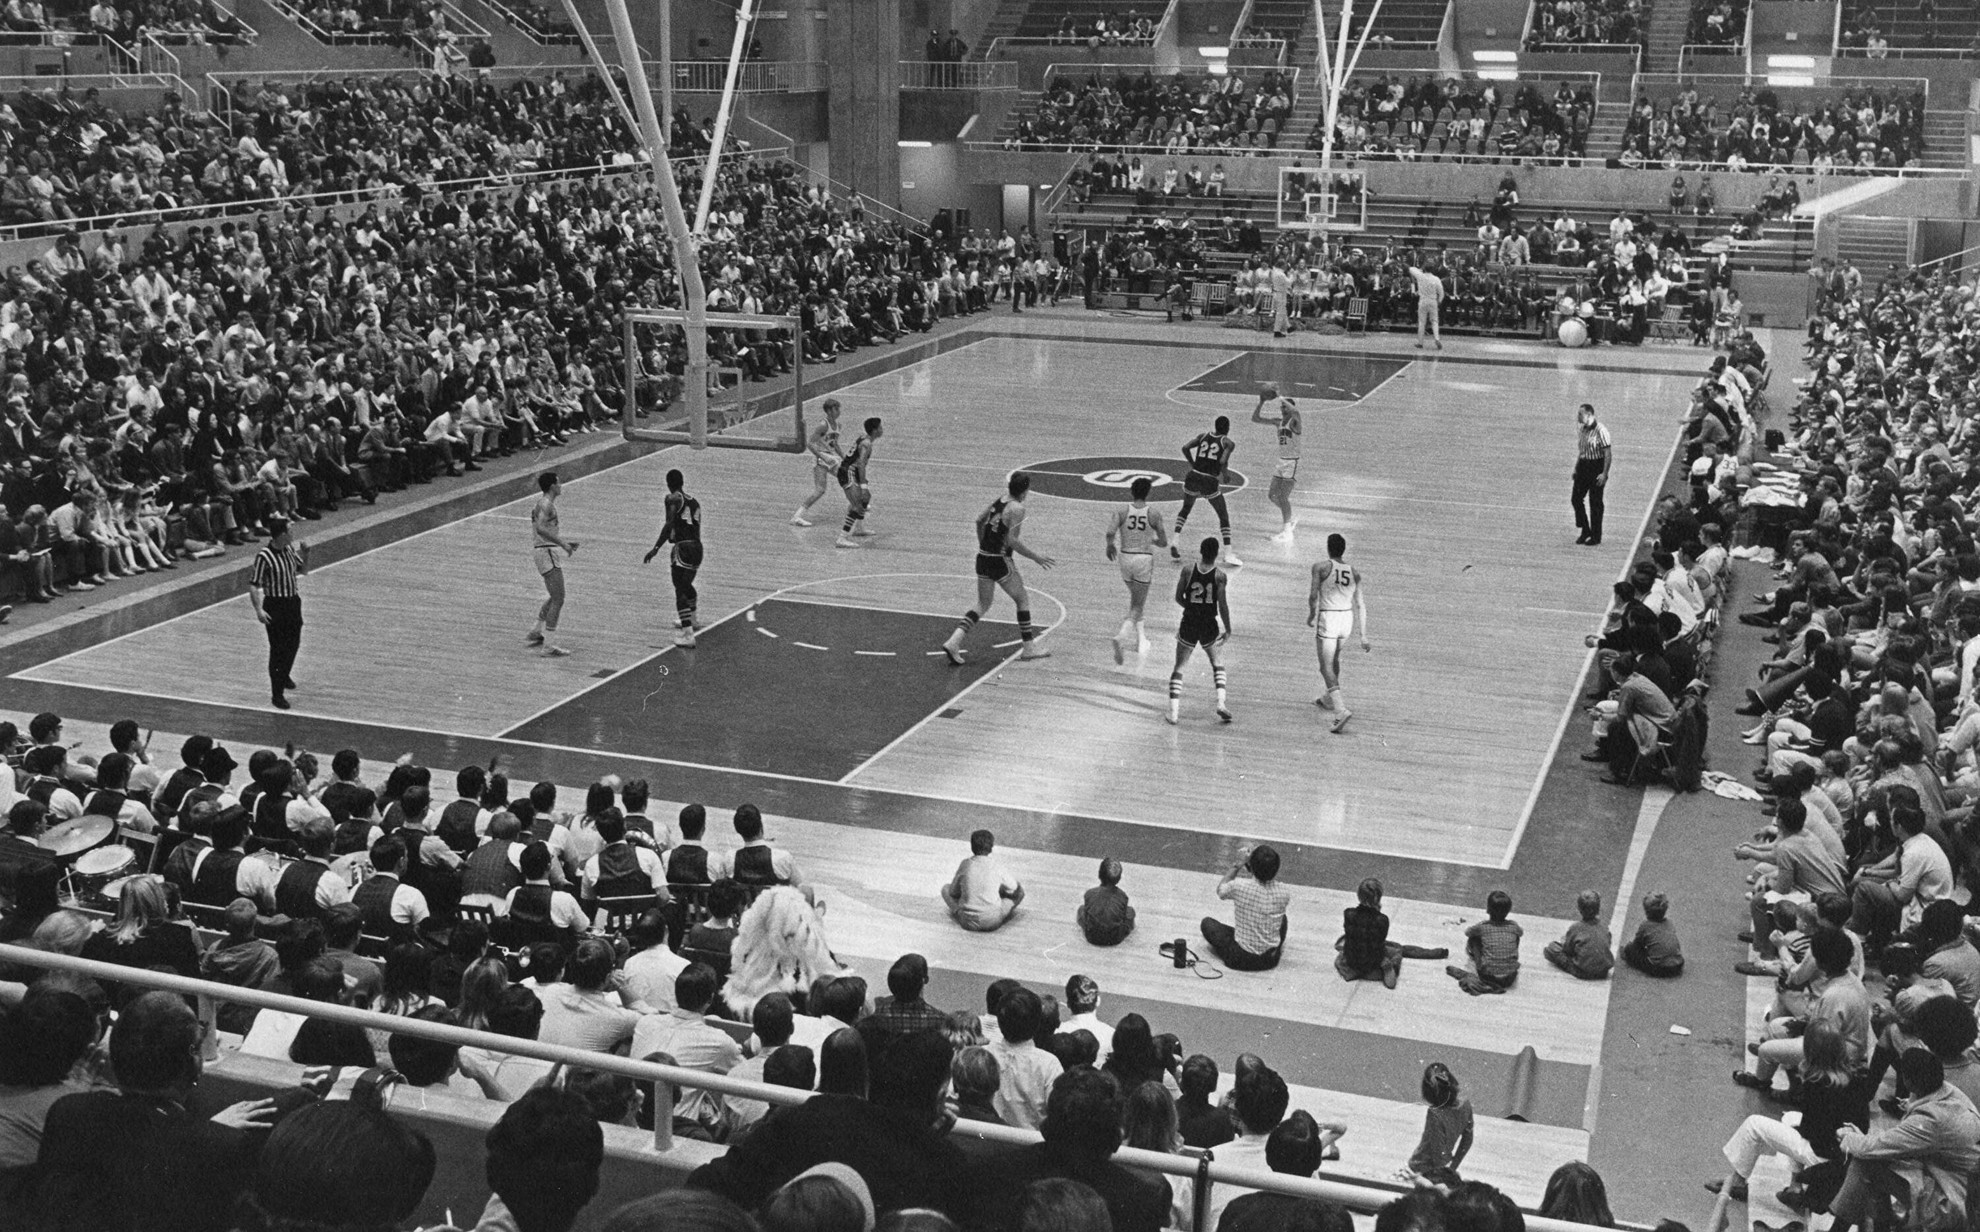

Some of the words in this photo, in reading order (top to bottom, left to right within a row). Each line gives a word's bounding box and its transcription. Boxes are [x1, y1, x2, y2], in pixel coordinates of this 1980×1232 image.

[1198, 441, 1220, 460] 22
[1094, 471, 1164, 487] S
[1127, 515, 1147, 531] 35
[1334, 569, 1351, 586] 15
[1190, 582, 1214, 604] 21
